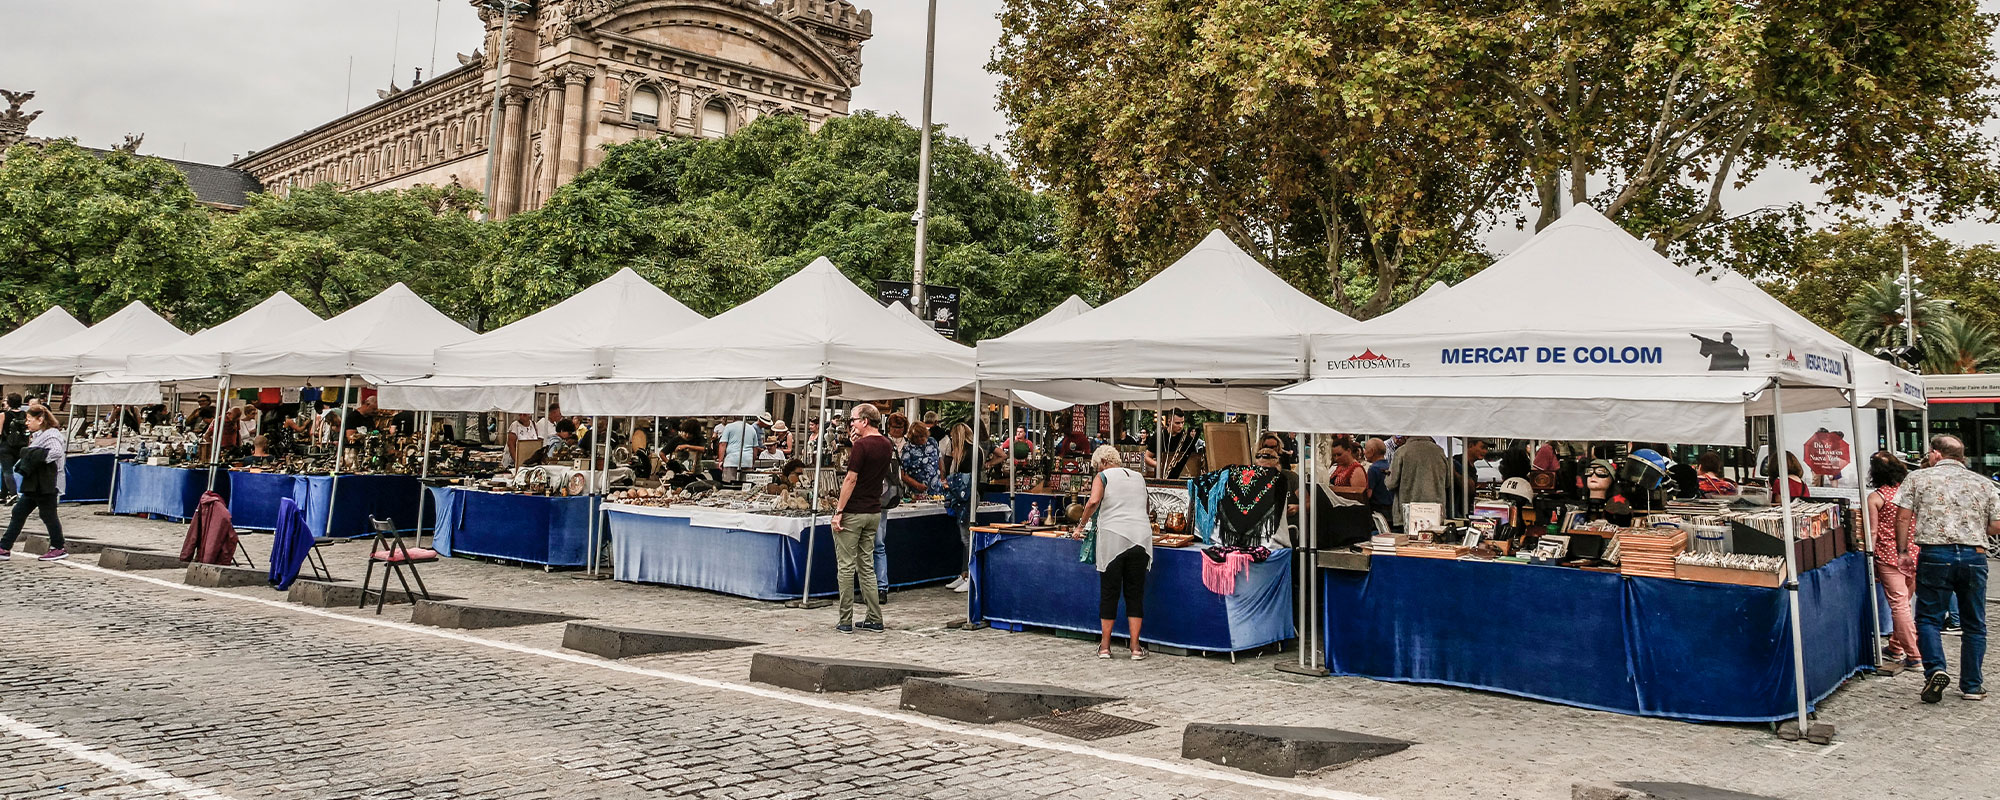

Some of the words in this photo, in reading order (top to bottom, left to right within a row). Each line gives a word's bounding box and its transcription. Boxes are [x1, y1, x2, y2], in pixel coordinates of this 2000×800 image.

[1441, 347, 1529, 364] MERCAT
[1536, 347, 1566, 363] DE
[1573, 347, 1662, 364] COLOM
[1327, 359, 1411, 370] EVENTOSAMT.es
